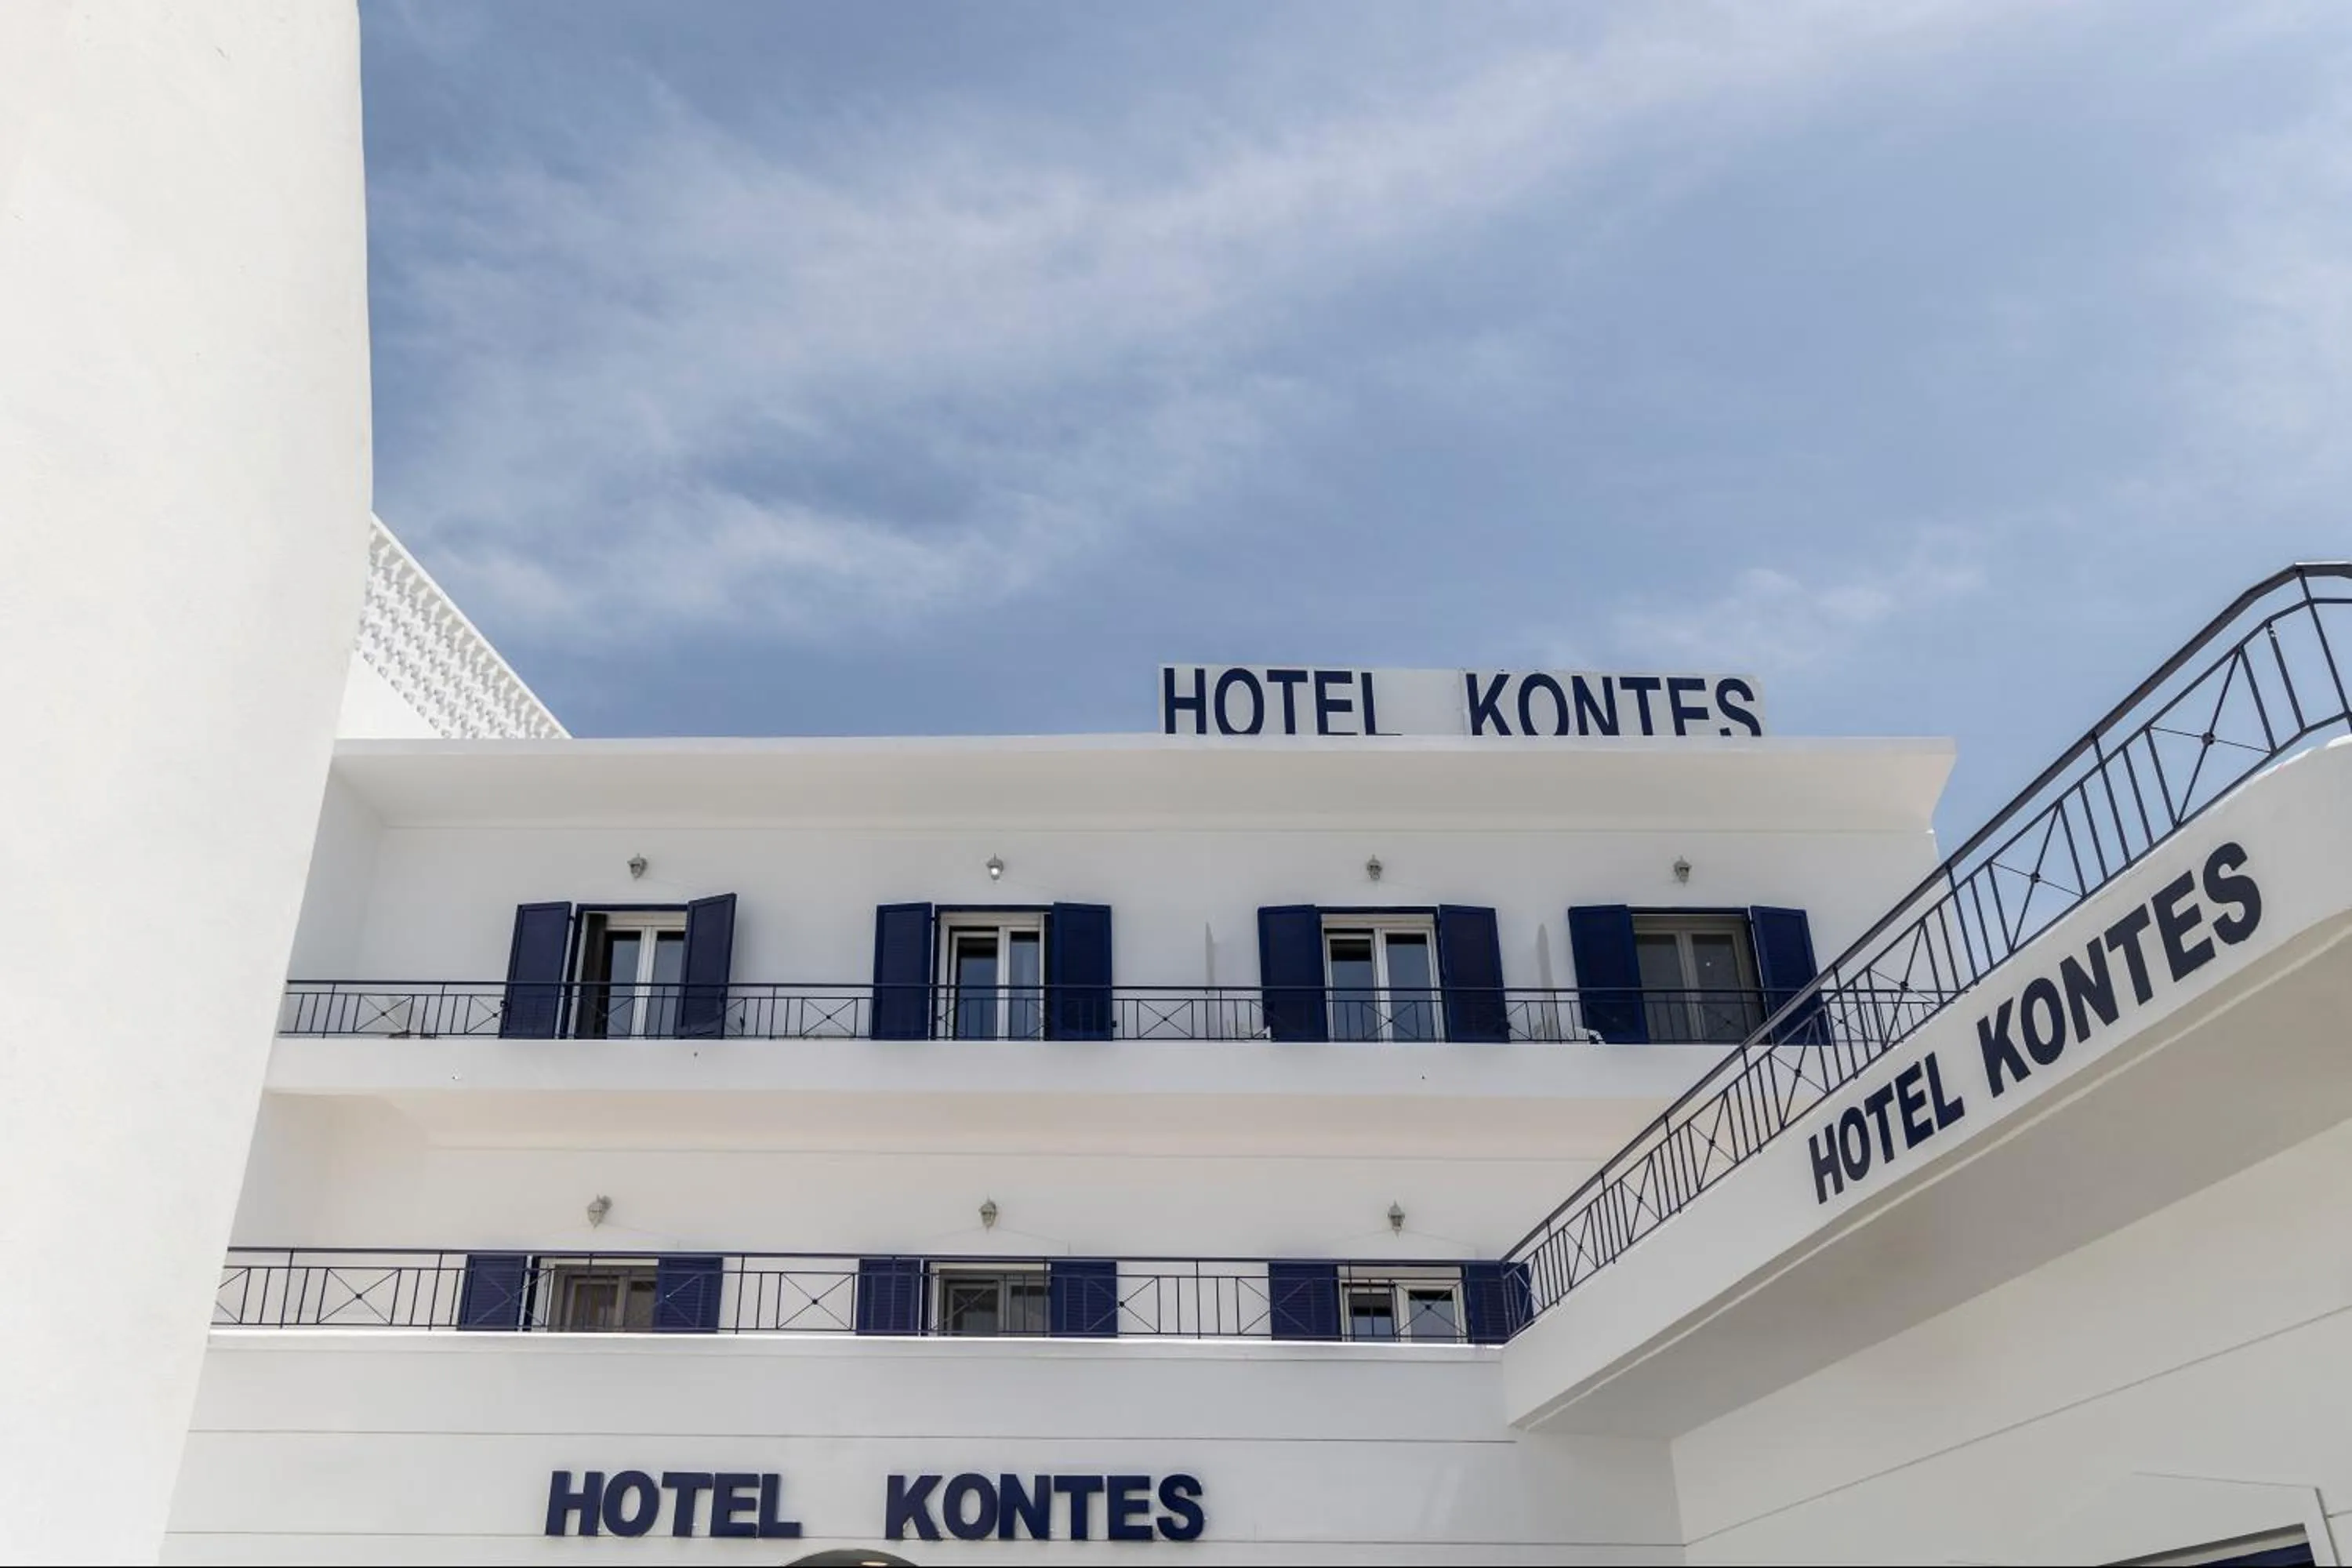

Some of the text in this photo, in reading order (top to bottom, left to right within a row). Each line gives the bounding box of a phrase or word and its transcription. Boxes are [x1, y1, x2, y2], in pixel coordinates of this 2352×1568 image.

[1163, 667, 1762, 737] HOTEL KONTES
[1808, 841, 2263, 1205] HOTEL KONTES
[544, 1470, 1206, 1543] HOTEL KONTES
